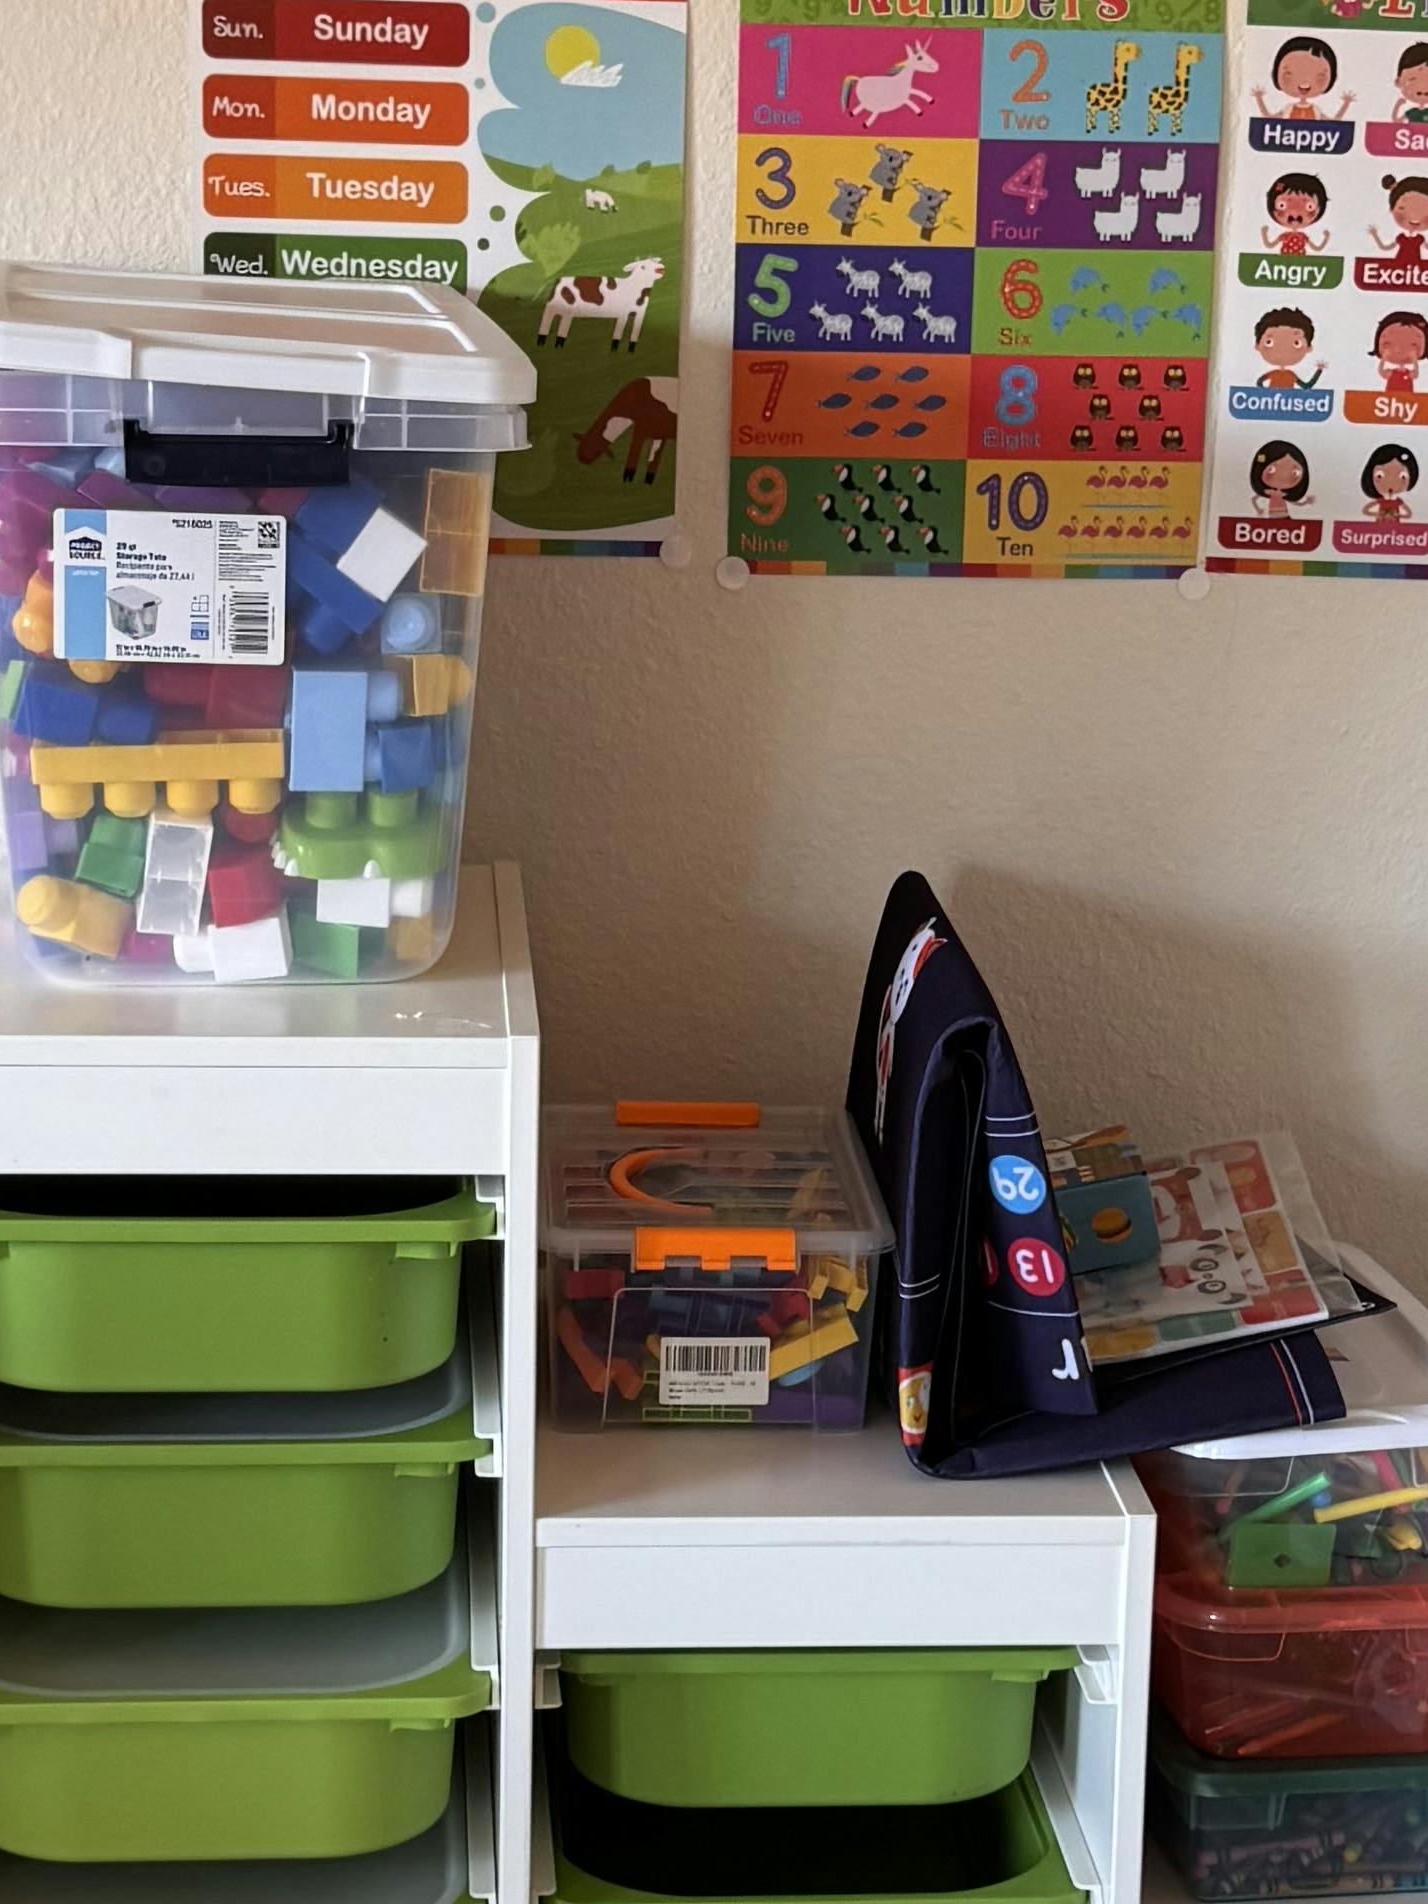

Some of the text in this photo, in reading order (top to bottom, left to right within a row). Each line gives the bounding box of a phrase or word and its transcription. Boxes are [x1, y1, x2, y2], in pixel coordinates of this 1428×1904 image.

[213, 17, 264, 39] Sun.
[313, 15, 429, 50] Sunday
[766, 34, 791, 100] 1
[1009, 40, 1051, 103] 2
[212, 95, 265, 119] Mon.
[311, 94, 430, 129] Monday
[1000, 109, 1049, 130] Two
[1263, 124, 1340, 152] Happy
[208, 175, 270, 198] Tues.
[306, 173, 434, 207] Tuesday
[755, 147, 793, 209] 3
[1001, 152, 1047, 216] 4
[746, 214, 809, 237] Three
[991, 221, 1041, 241] Four
[209, 254, 268, 275] Wed.
[280, 250, 458, 286] Wednesday
[1254, 261, 1326, 286] Angry
[747, 253, 798, 317] 5
[1000, 259, 1042, 320] 6
[752, 322, 795, 342] Five
[998, 328, 1031, 347] Six
[749, 360, 789, 422] 7
[994, 365, 1038, 426] 8
[1232, 392, 1329, 413] Confused
[1374, 396, 1418, 421] Shy
[739, 427, 804, 445] Seven
[745, 465, 788, 526] 9
[976, 471, 1049, 531] 10
[997, 537, 1034, 557] Ten
[1234, 523, 1306, 544] Bored
[1341, 530, 1427, 550] Surprised
[993, 1166, 1039, 1201] 29
[1015, 1249, 1054, 1283] 13
